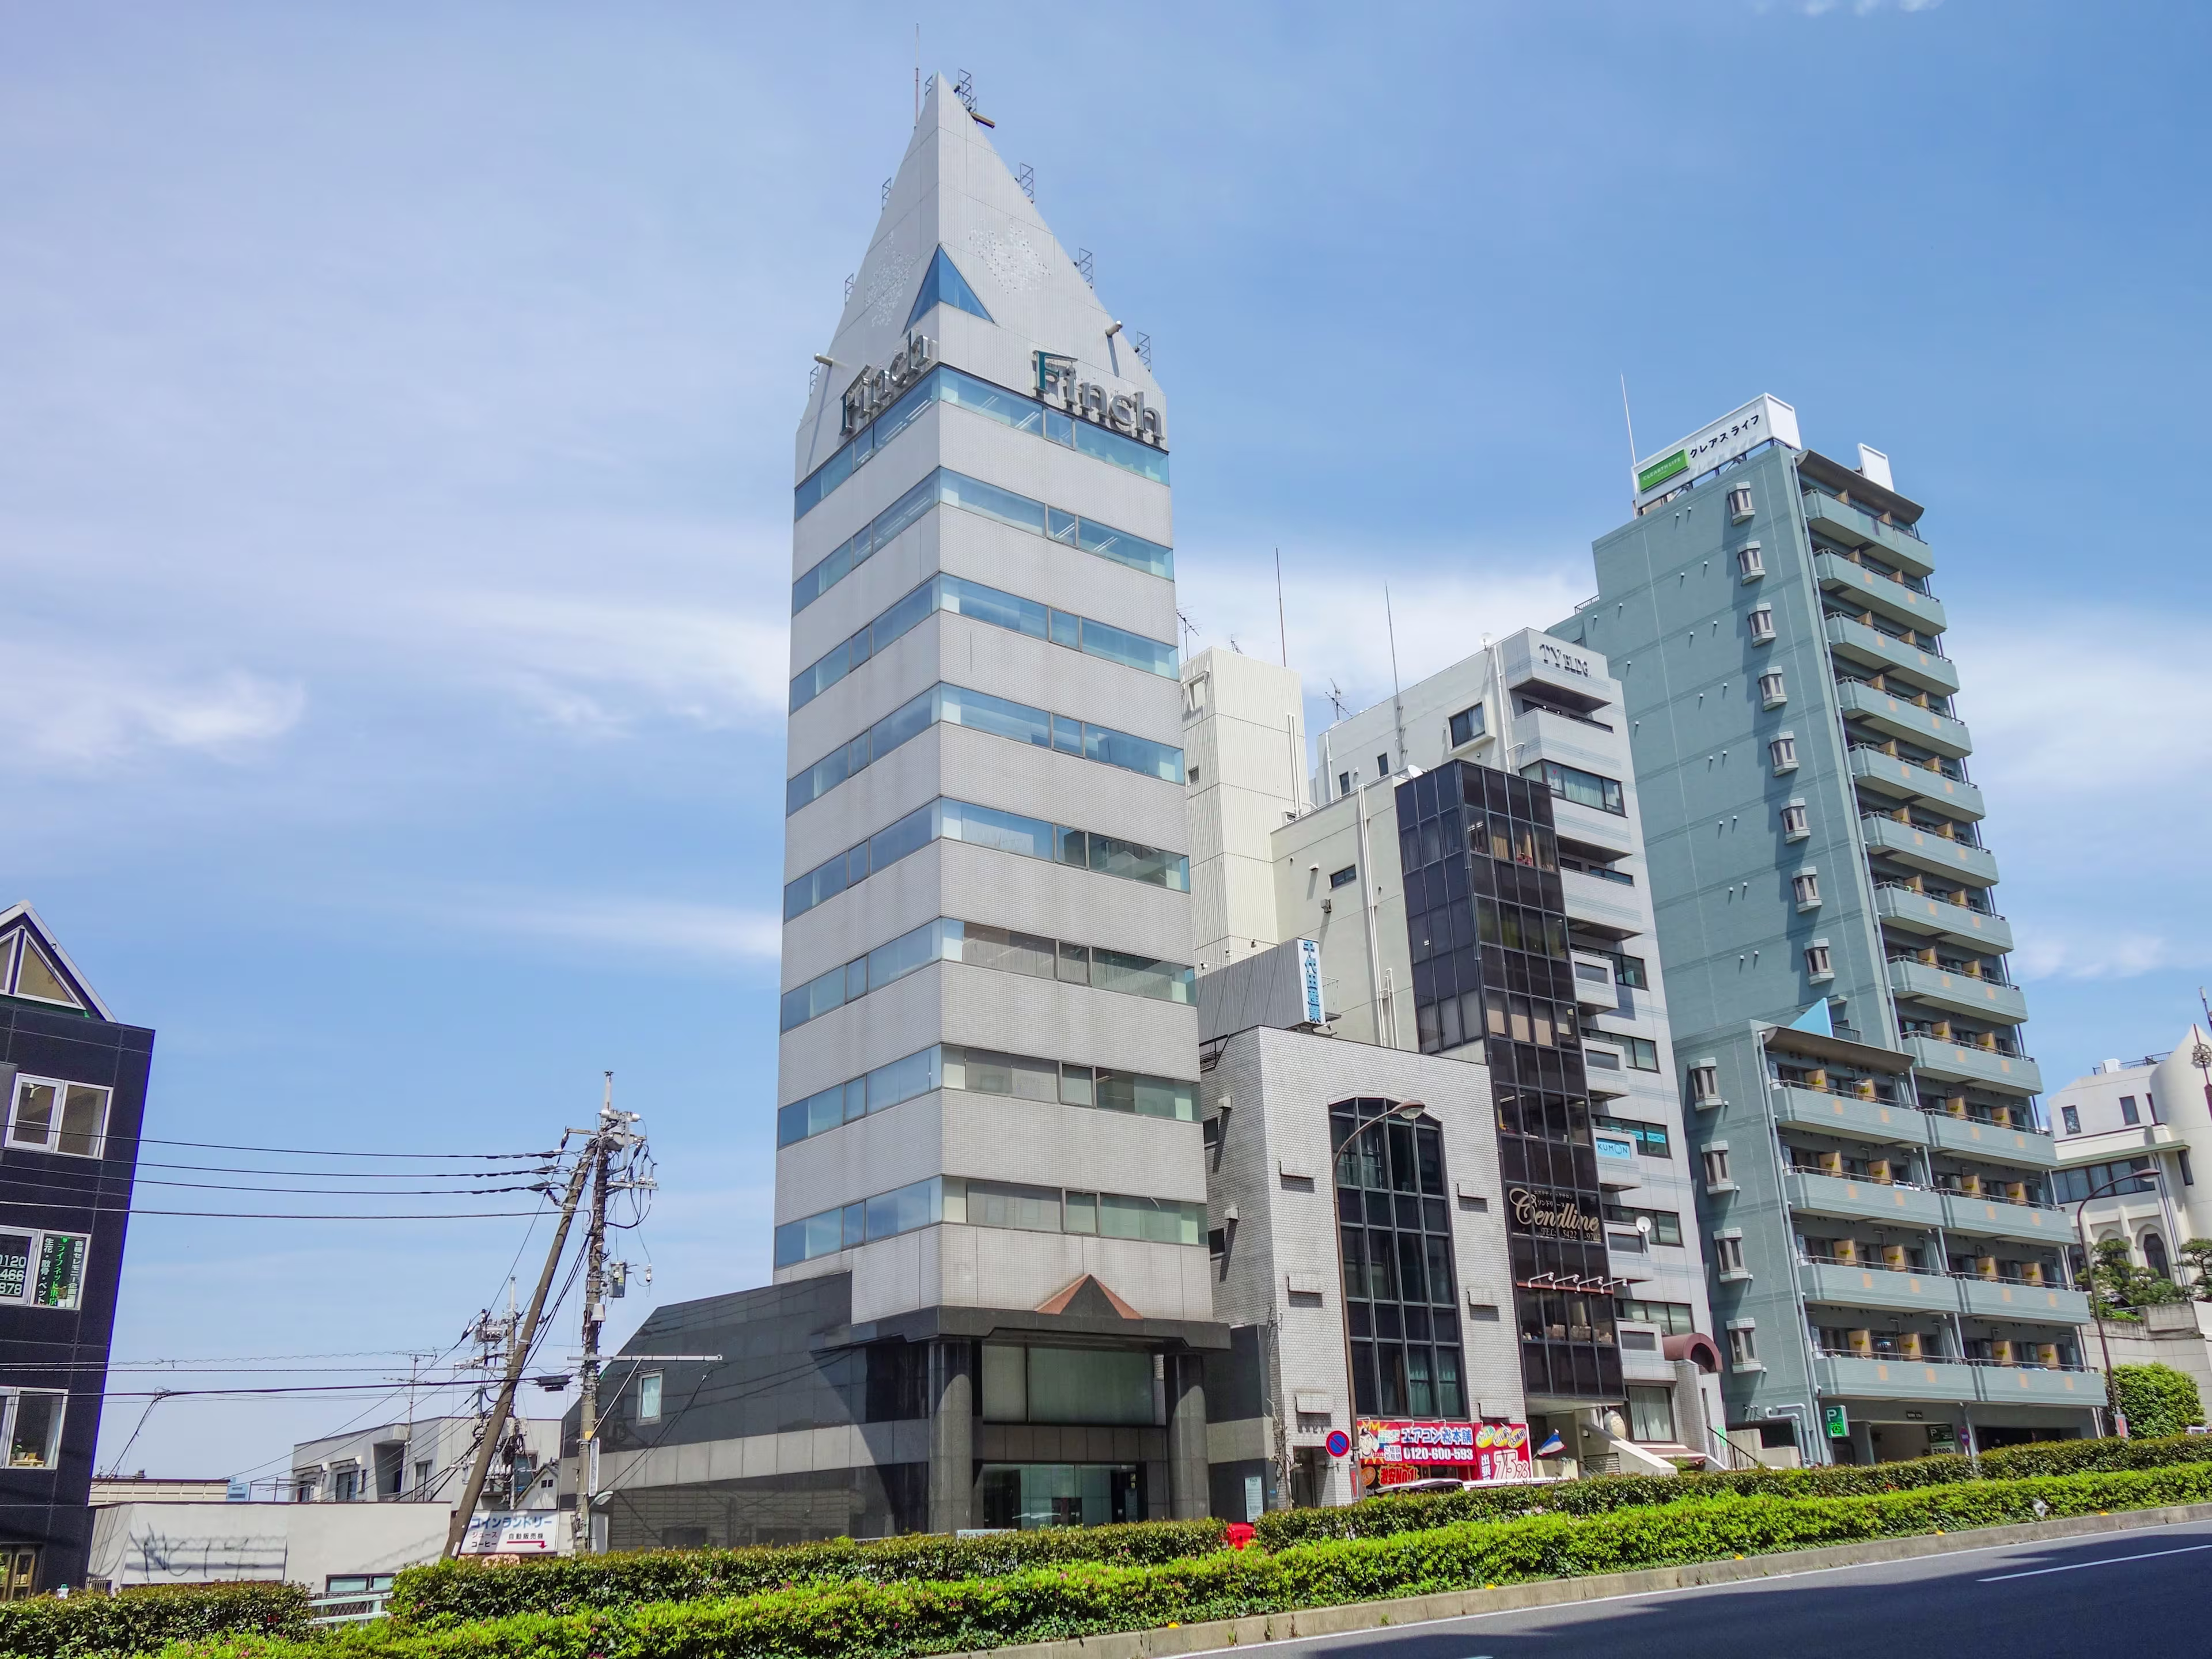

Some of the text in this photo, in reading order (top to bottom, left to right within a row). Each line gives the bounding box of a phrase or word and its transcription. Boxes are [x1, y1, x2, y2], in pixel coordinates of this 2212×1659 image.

[840, 328, 931, 436] Finch
[1033, 350, 1165, 445] Finch
[1643, 464, 1669, 480] CLEARTH
[1669, 457, 1681, 467] LIFE
[1539, 644, 1562, 668] TY
[1302, 940, 1321, 1023] 千代田産業
[1598, 1142, 1628, 1154] KUMON
[1562, 1230, 1577, 1239] 5422
[49, 1243, 65, 1306] ライフネット東京
[1826, 1409, 1838, 1422] P
[1402, 1427, 1473, 1444] エアコン総本舗
[1510, 1430, 1526, 1446] 店舗用
[1930, 1429, 1937, 1437] P
[1403, 1447, 1474, 1460] 0120-600-593
[1495, 1450, 1529, 1480] 75%
[470, 1516, 552, 1529] コインランドリー
